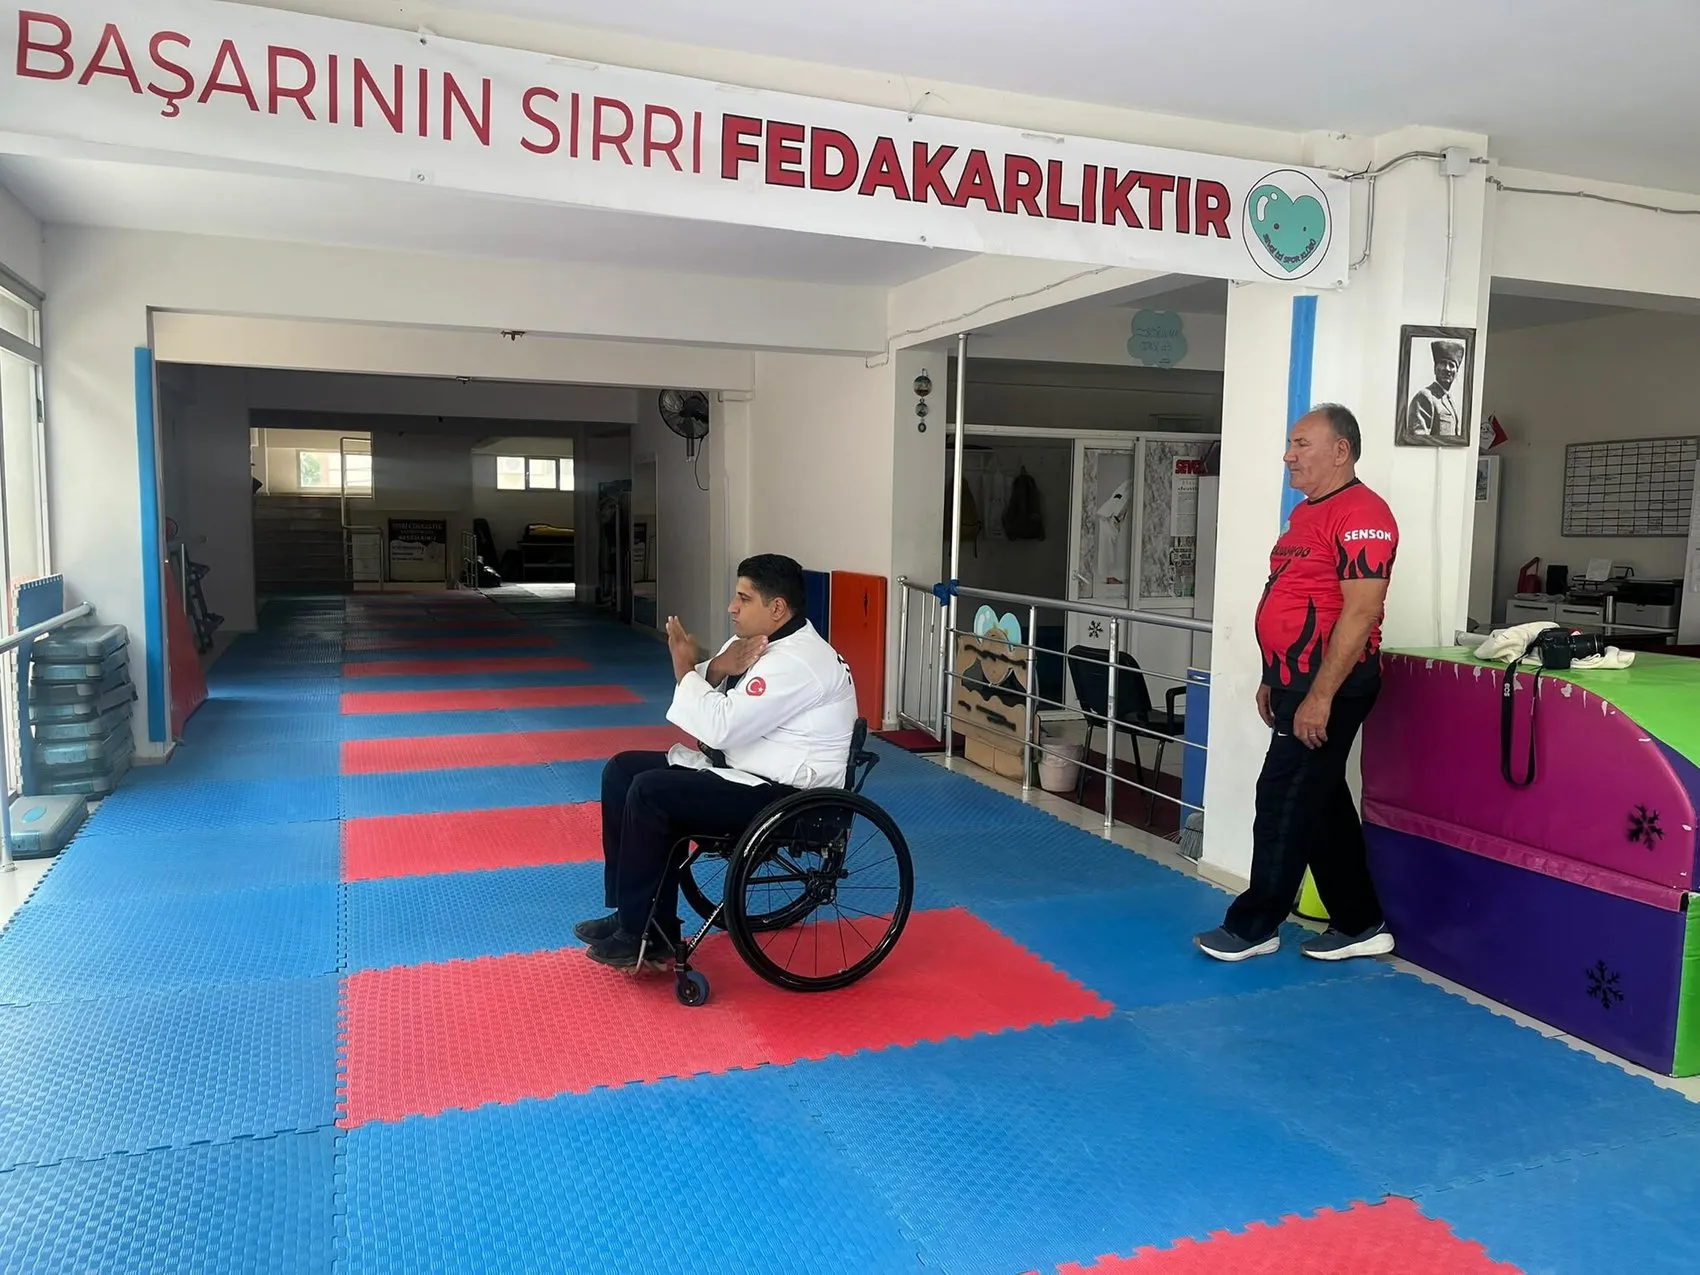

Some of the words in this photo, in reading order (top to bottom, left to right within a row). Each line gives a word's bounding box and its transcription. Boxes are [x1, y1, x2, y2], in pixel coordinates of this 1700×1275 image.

[15, 10, 493, 147] BAŞARININ
[520, 86, 703, 174] SIRRI
[720, 111, 1232, 240] FEDAKARLIKTIR
[1344, 528, 1392, 541] SENSON
